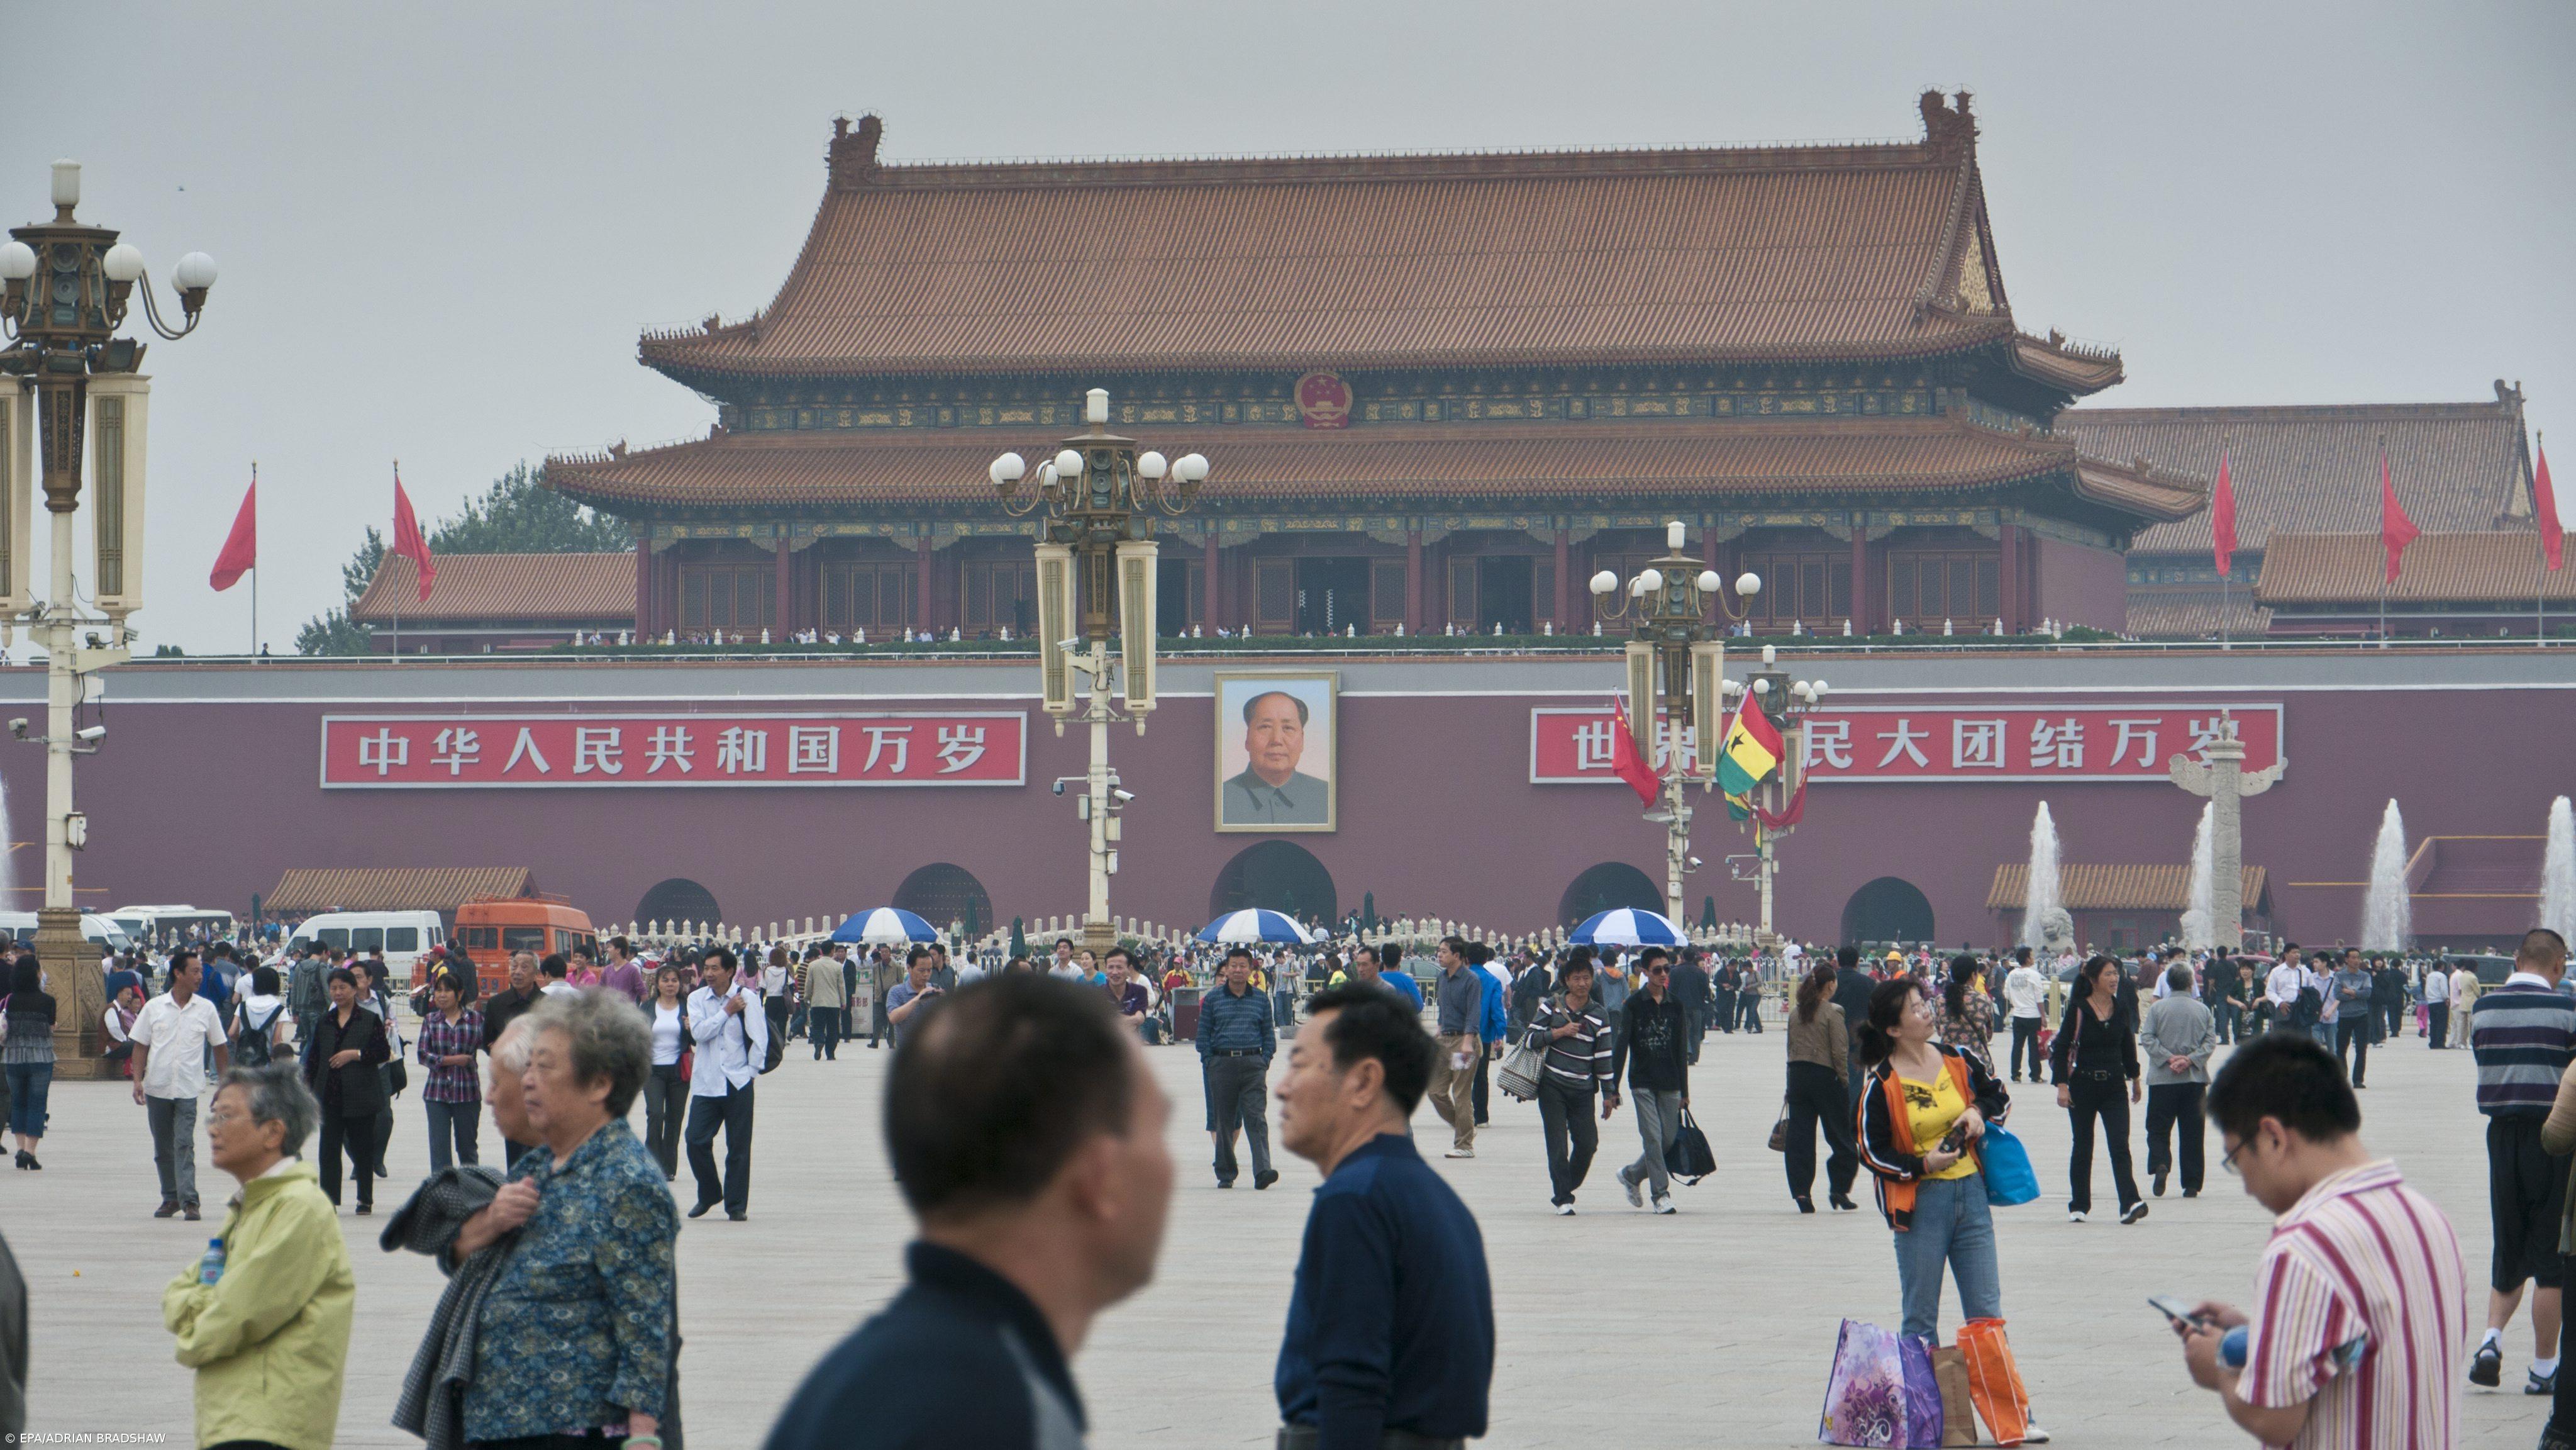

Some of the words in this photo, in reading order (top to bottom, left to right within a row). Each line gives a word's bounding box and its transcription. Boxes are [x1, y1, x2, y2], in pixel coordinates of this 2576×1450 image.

[360, 725, 985, 775] 中华人民共和国万岁
[1572, 718, 2240, 769] 世界民大团结万岁
